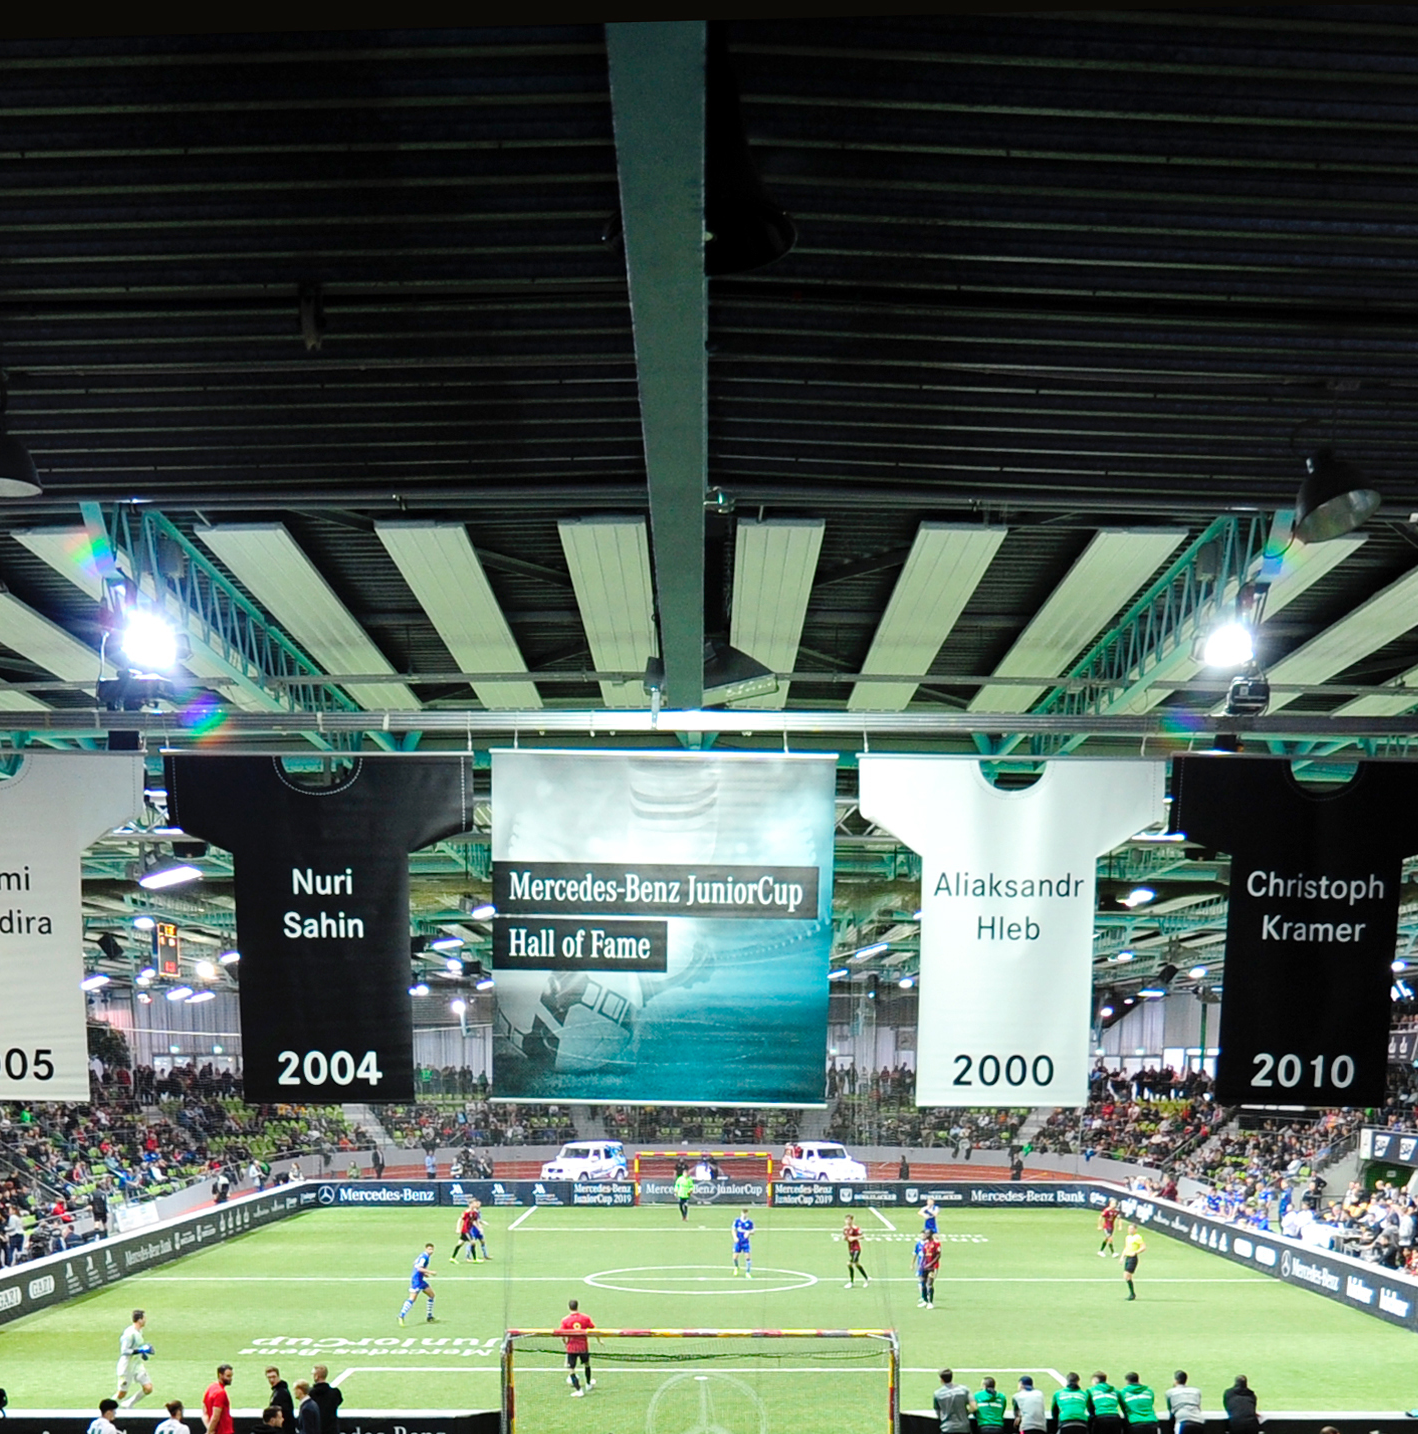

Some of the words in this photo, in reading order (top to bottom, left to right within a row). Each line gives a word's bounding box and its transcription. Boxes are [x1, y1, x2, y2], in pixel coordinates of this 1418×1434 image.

[292, 867, 352, 895] Nuri
[508, 871, 681, 903] Mercedes-Benz
[686, 875, 803, 911] JuniorCup
[933, 871, 1084, 898] Aliaksandr
[1246, 870, 1384, 906] Christoph
[283, 911, 364, 940] Sahin
[976, 914, 1041, 941] Hleb
[1261, 914, 1366, 943] Kramer
[508, 927, 555, 958] Hall
[561, 929, 585, 958] of
[590, 930, 651, 960] Fame
[277, 1049, 382, 1085] 2004
[952, 1053, 1055, 1087] 2000
[1251, 1053, 1354, 1088] 2010
[339, 1187, 435, 1201] Mercedes-Benz
[573, 1183, 631, 1194] Mercedes-Benz
[613, 1194, 632, 1204] 2019
[717, 1183, 763, 1196] JuniorCup
[774, 1183, 833, 1194] Mercedes-Benz
[813, 1195, 833, 1204] 2019
[971, 1190, 1054, 1202] Mercedes-Benz
[1057, 1190, 1085, 1202] Bank
